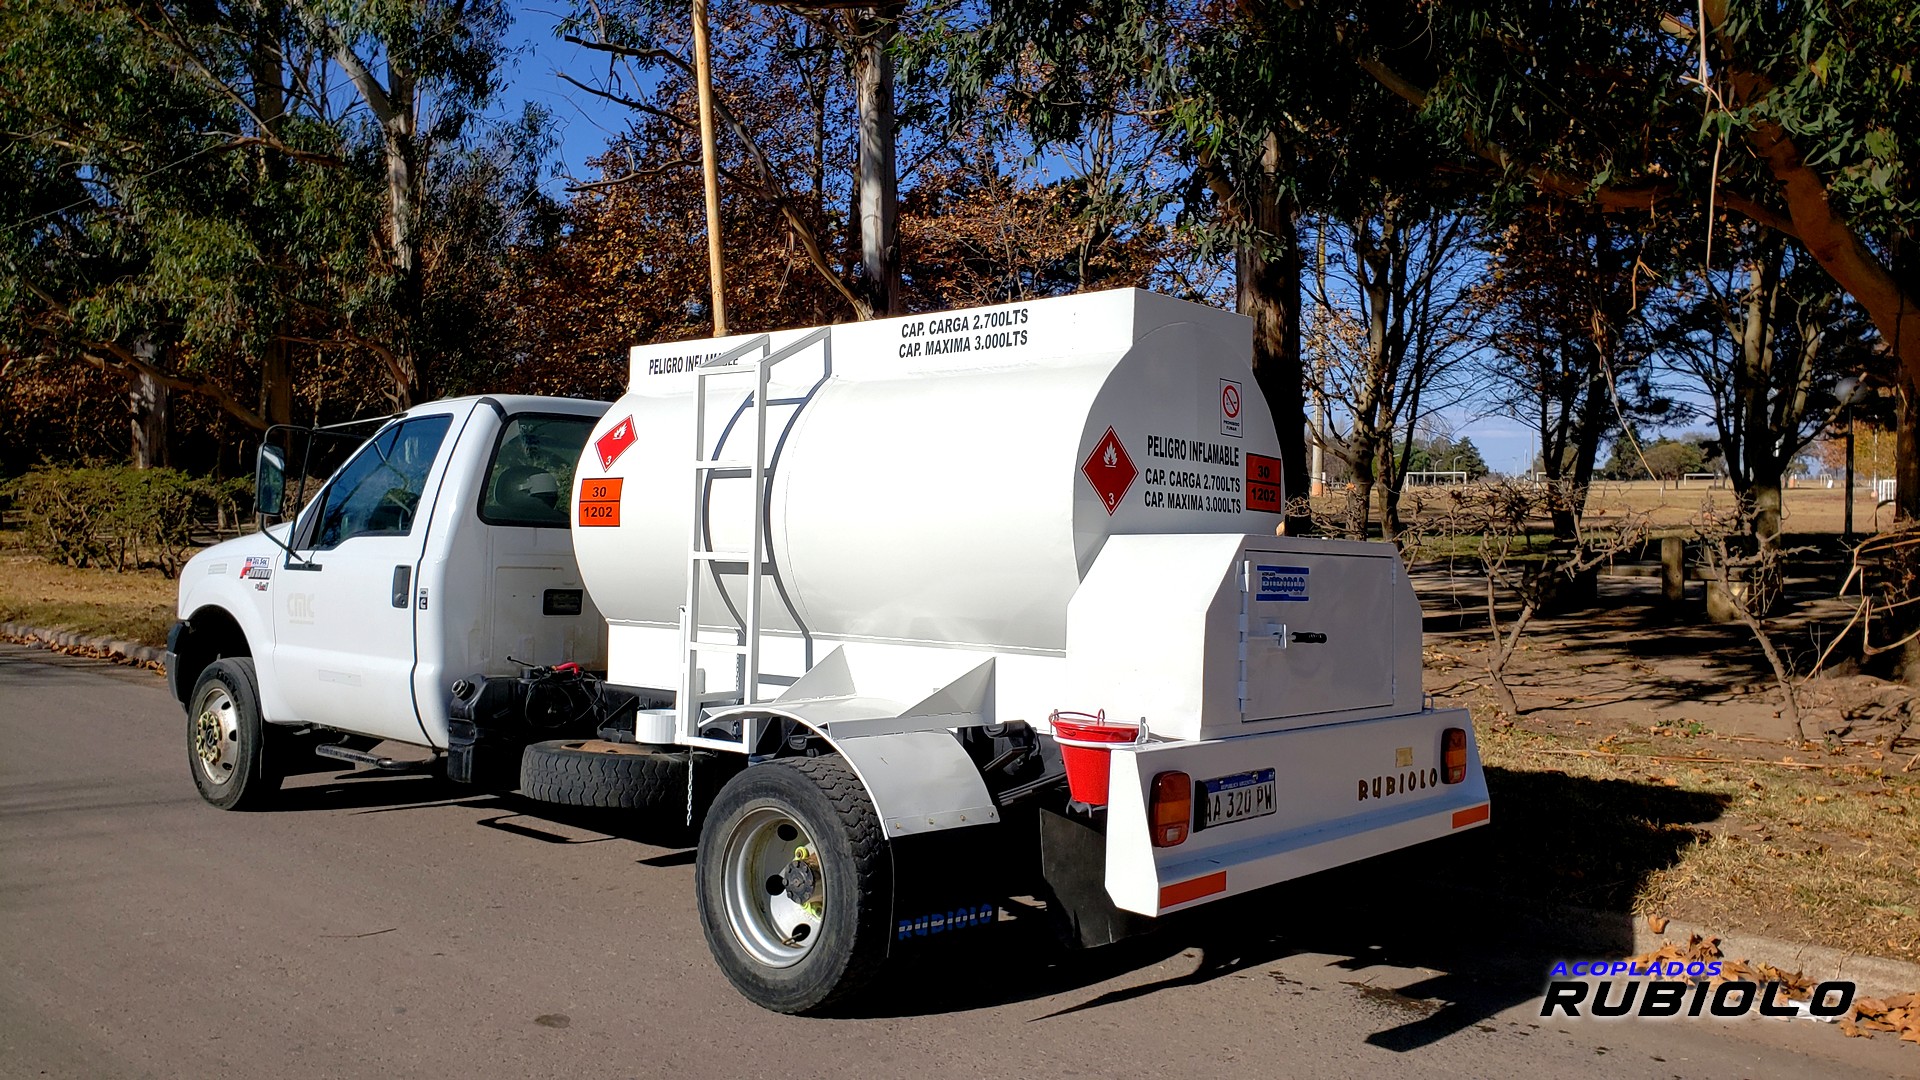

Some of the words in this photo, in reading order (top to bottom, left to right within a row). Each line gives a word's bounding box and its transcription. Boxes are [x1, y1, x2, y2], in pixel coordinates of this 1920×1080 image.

[901, 322, 925, 338] CAP.
[929, 316, 969, 335] CARGA
[973, 308, 1028, 330] 2.700LTS
[899, 342, 922, 358] CAP.
[925, 337, 971, 356] MAXIMA
[974, 330, 1028, 350] 3.000LTS
[649, 356, 683, 375] PELIGRO
[606, 456, 612, 465] 3
[1147, 435, 1187, 460] PELIGRO
[1189, 441, 1240, 466] INFLAMABLE
[1145, 468, 1166, 485] CAP.
[1169, 471, 1202, 489] CARGA
[1203, 474, 1241, 492] 2.700LTS
[1257, 465, 1270, 478] 30
[592, 486, 607, 497] 30
[1108, 492, 1115, 505] 3
[1144, 491, 1165, 508] CAP.
[1167, 493, 1204, 511] MAXIMA
[1205, 496, 1241, 513] 3.000LTS
[1251, 488, 1276, 502] 1202
[583, 506, 613, 517] 1202
[1358, 768, 1438, 801] RUBIOLO
[1226, 790, 1251, 818] 320
[898, 903, 992, 941] RUBIOLO
